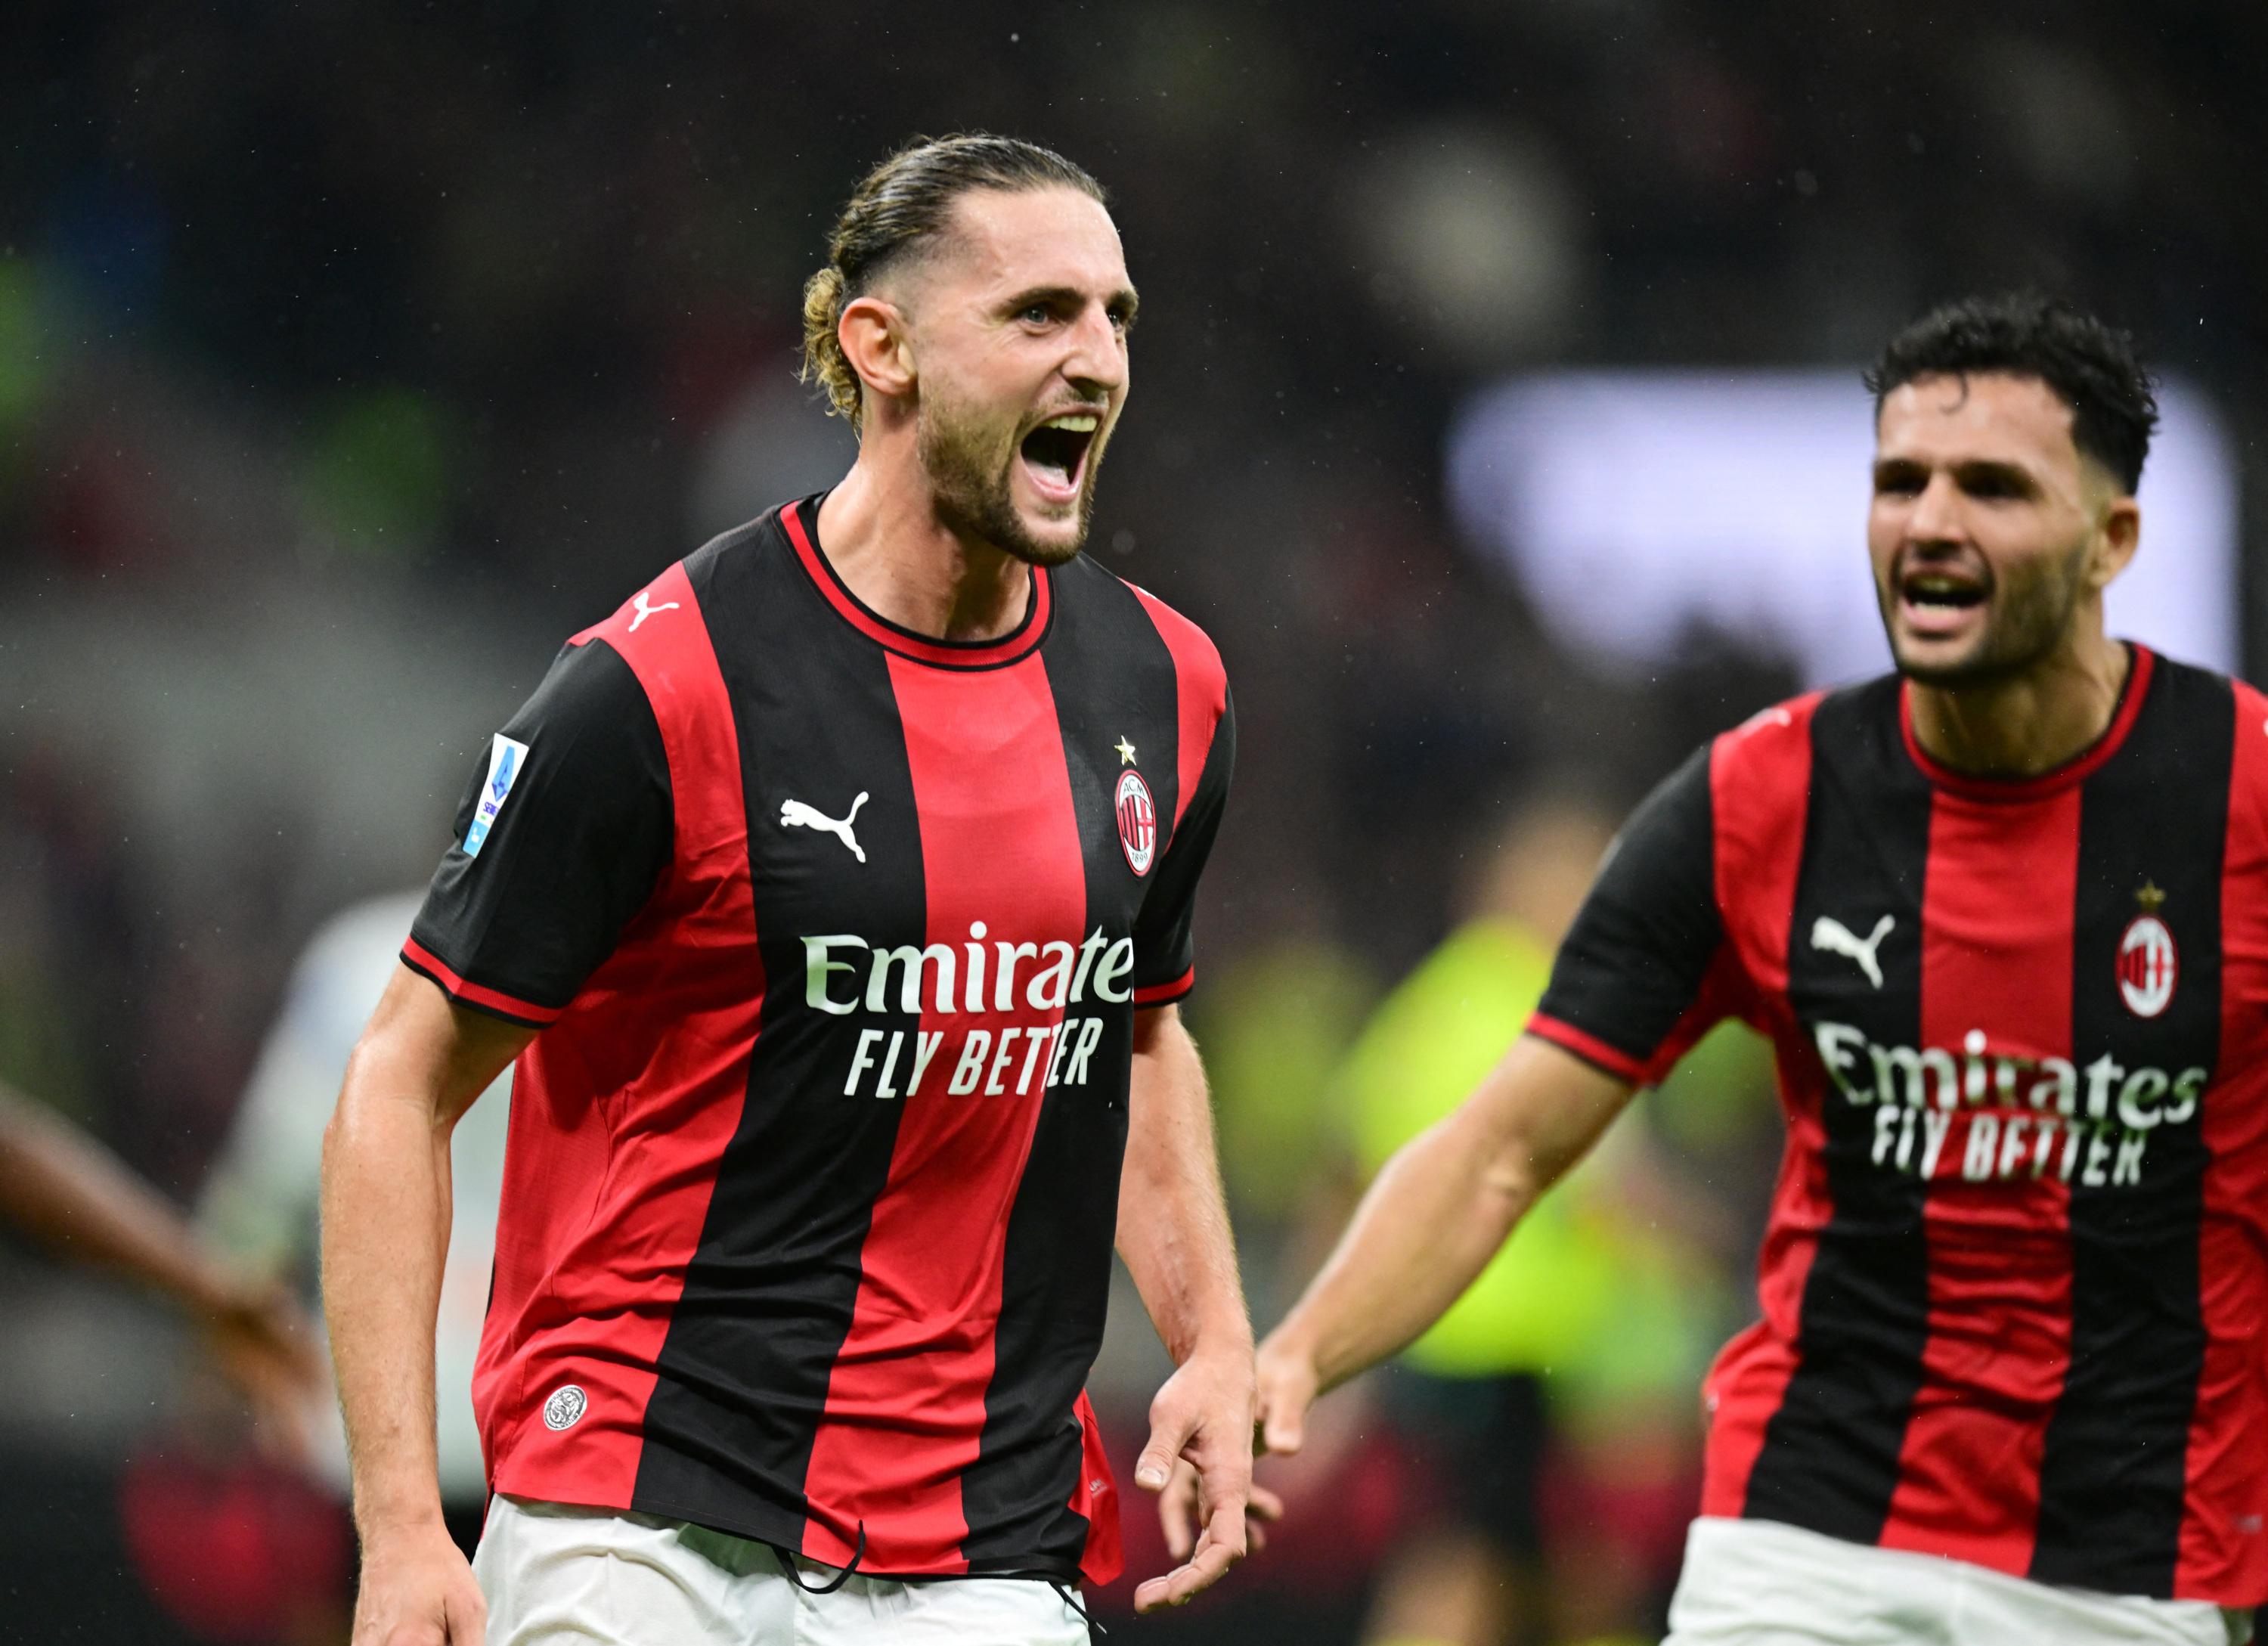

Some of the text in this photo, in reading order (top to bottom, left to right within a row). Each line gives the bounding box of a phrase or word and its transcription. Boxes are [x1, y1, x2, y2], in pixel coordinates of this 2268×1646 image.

[1123, 778, 1145, 798] ACM
[799, 920, 1135, 1015] Emirate
[843, 1017, 1104, 1099] FLY BETTER
[1814, 1021, 2208, 1130] Emirates
[1871, 1104, 1953, 1181] FLY
